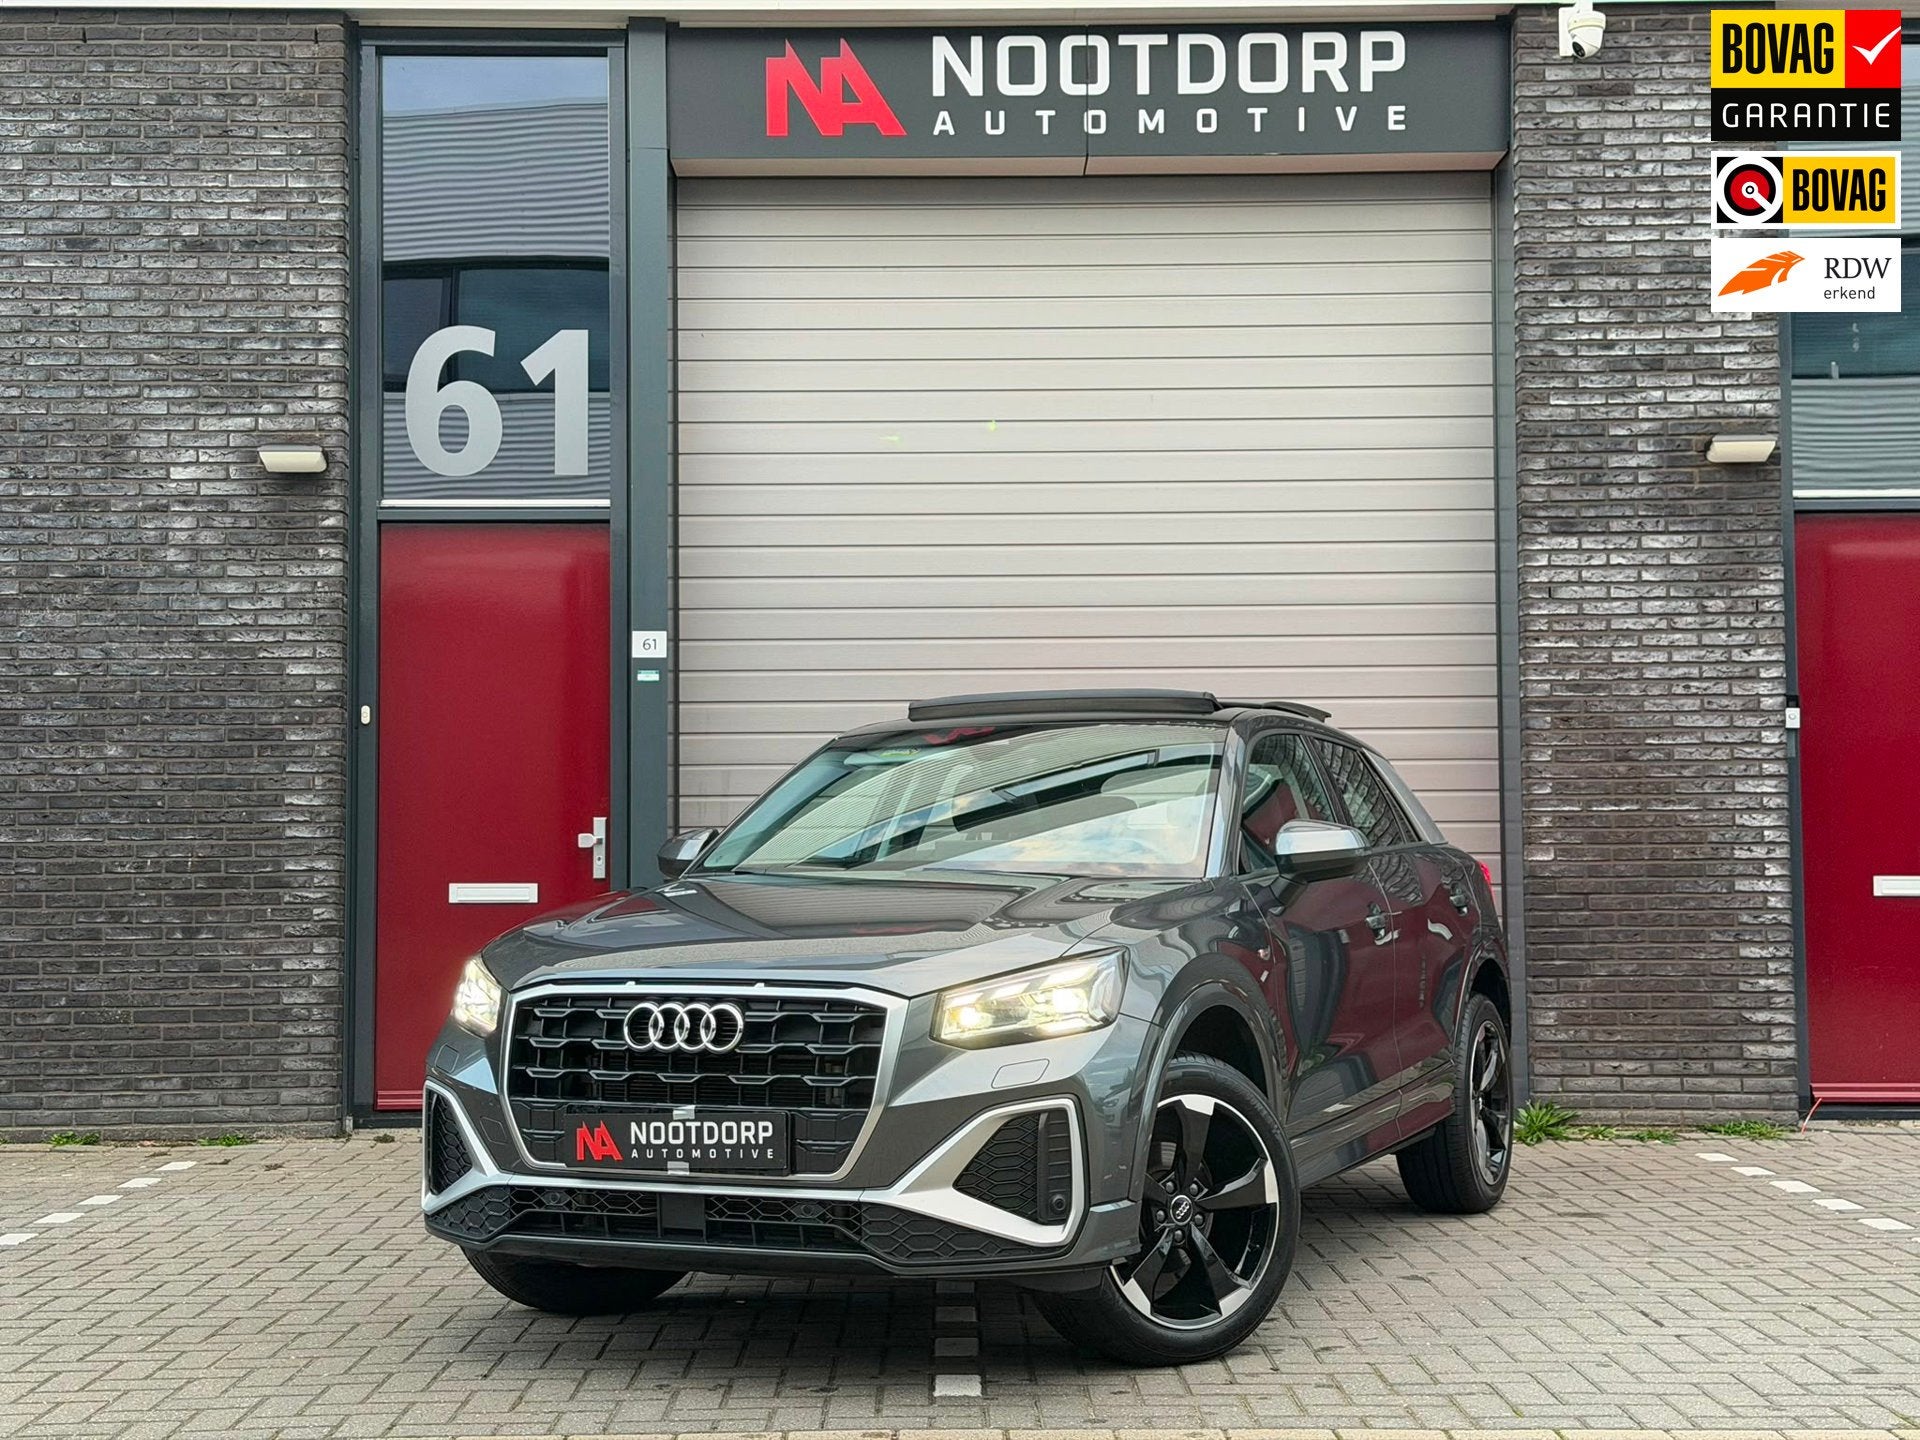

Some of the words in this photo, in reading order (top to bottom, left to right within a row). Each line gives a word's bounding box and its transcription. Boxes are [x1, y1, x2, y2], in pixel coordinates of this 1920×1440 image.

[931, 30, 1407, 97] NOOTDORP
[765, 38, 907, 137] NA
[932, 105, 1407, 136] AUTOMOTIVE
[405, 325, 589, 477] 61
[642, 638, 657, 651] 61
[630, 1121, 773, 1145] NOOTDORP
[631, 1148, 774, 1159] AUTOMOTIVE
